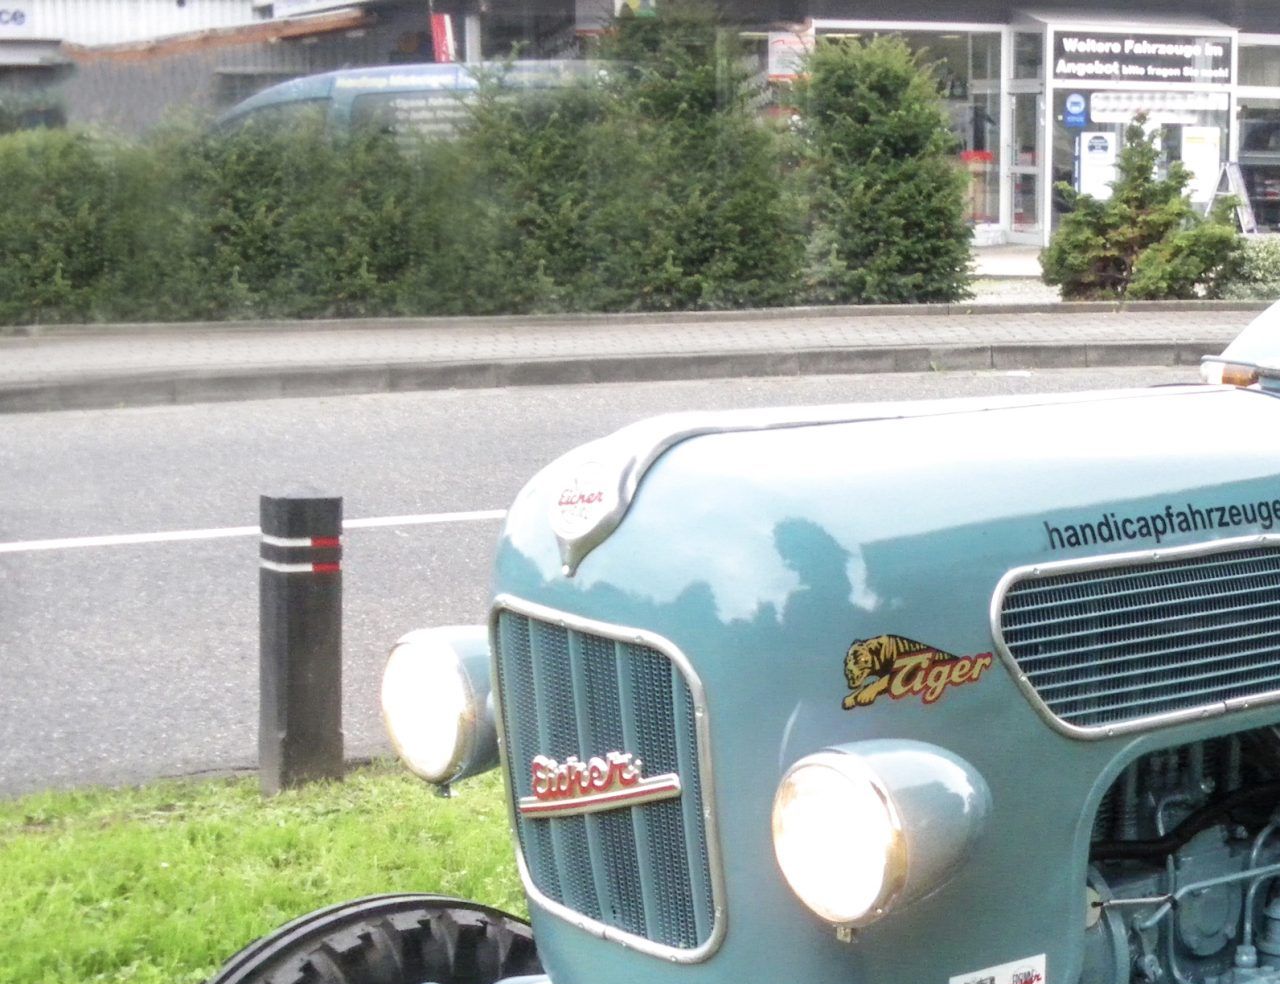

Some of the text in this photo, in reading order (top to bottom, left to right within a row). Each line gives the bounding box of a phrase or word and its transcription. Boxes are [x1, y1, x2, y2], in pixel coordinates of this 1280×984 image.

[1062, 38, 1121, 53] Weitere
[1124, 40, 1202, 58] Fahrzeuge
[1056, 59, 1120, 76] Angebot
[1122, 65, 1145, 75] bitte
[1147, 66, 1180, 77] fragen
[1183, 67, 1200, 76] Sie
[889, 650, 993, 704] Tiger
[531, 750, 642, 799] Eicher
